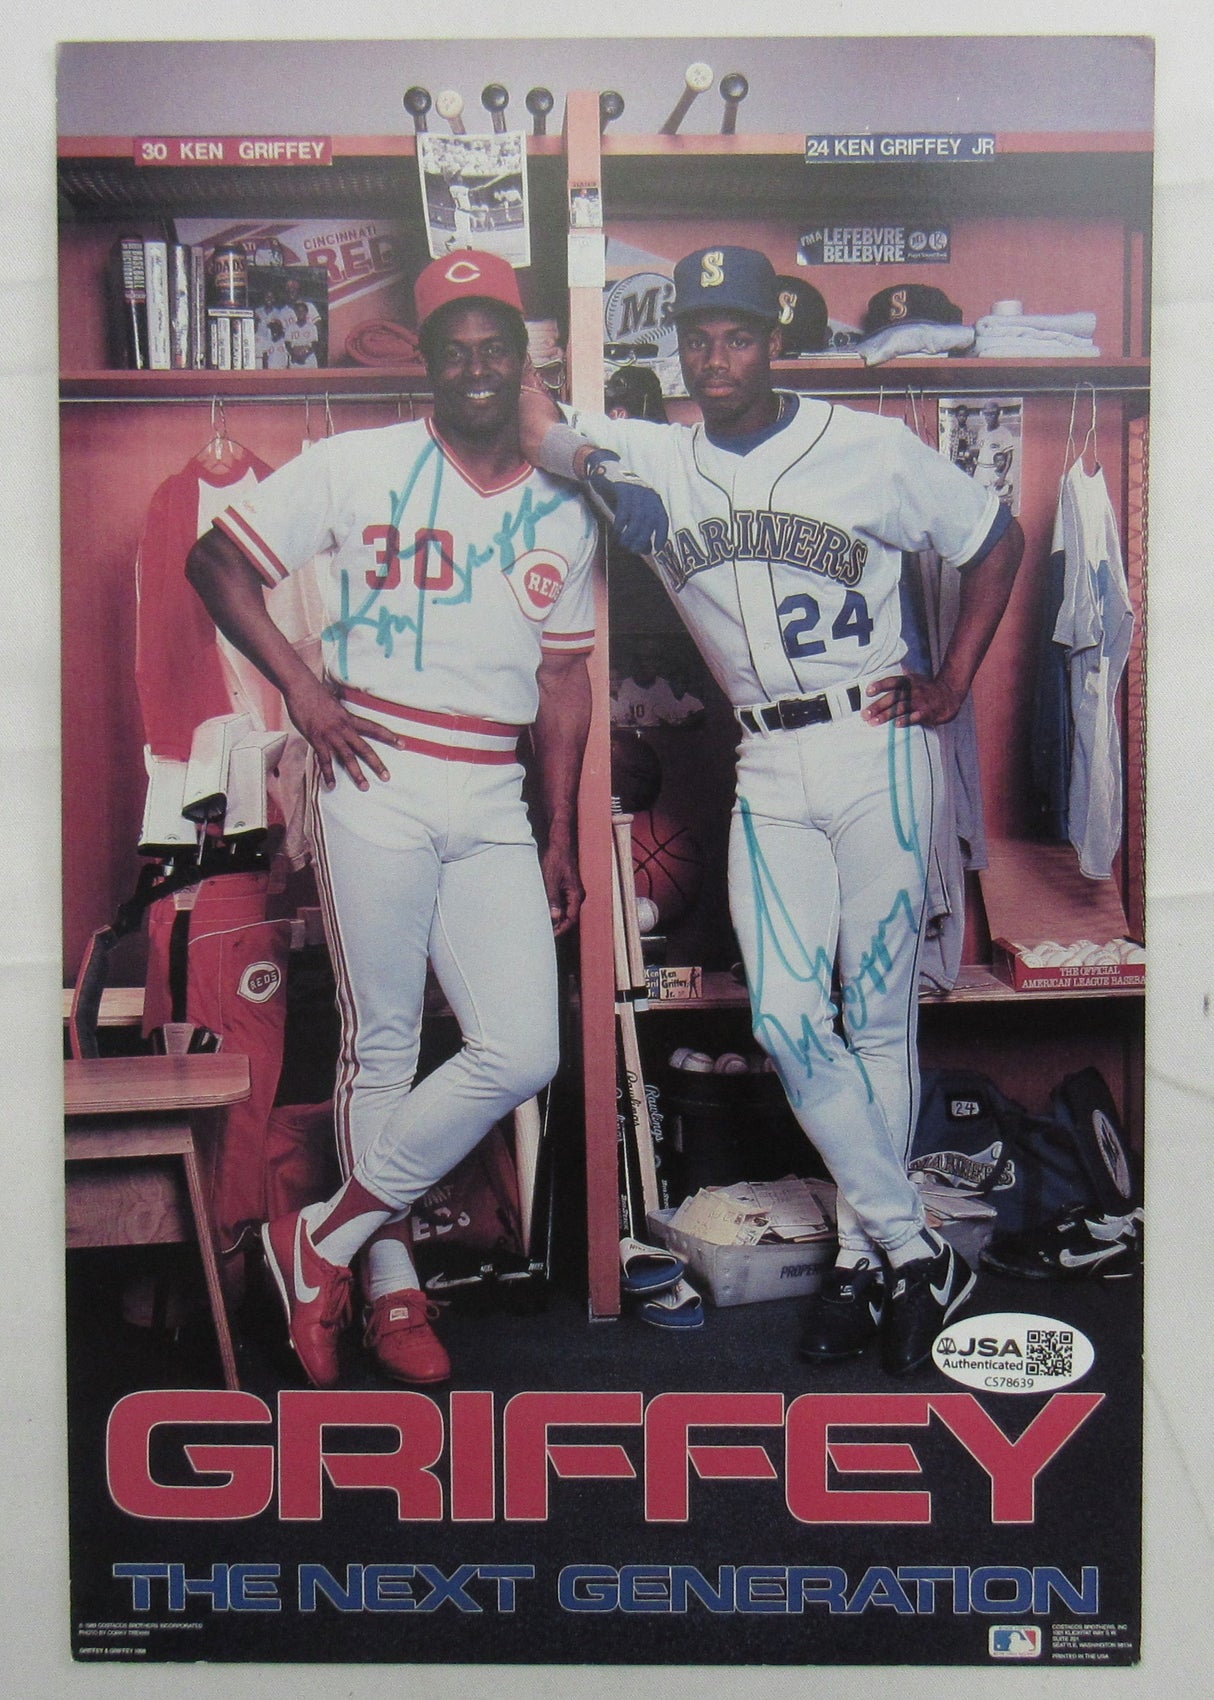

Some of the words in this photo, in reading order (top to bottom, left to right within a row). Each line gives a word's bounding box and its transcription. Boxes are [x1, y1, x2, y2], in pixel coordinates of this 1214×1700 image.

[142, 142, 167, 160] 30
[180, 142, 223, 160] KEN
[239, 141, 325, 160] GRIFFEY
[807, 139, 829, 157] 24
[835, 138, 874, 157] KEN
[880, 138, 960, 156] GRIFFEY
[972, 137, 995, 155] JR
[303, 225, 377, 250] CINCINNATI
[823, 227, 905, 245] LEFEBVRE
[823, 245, 905, 263] BELEBVRE
[700, 250, 724, 288] S
[890, 290, 908, 320] S
[361, 524, 454, 591] 30
[777, 589, 874, 659] 24
[250, 971, 278, 991] REDS
[661, 969, 677, 980] Ken
[1059, 967, 1079, 977] THE
[1080, 965, 1120, 976] OFFICIAL
[1022, 978, 1071, 989] AMERICAN
[1073, 976, 1110, 987] LEAGUE
[644, 1084, 665, 1143] Rawlings
[954, 1101, 976, 1115] 24
[957, 1337, 1023, 1358] JSA
[942, 1358, 1024, 1371] Authenticated
[984, 1376, 1034, 1388] CS78639
[106, 1389, 1106, 1524] GRIFFEY
[112, 1562, 282, 1612] THE
[297, 1563, 536, 1613] NEXT
[557, 1563, 1100, 1615] GENERATION
